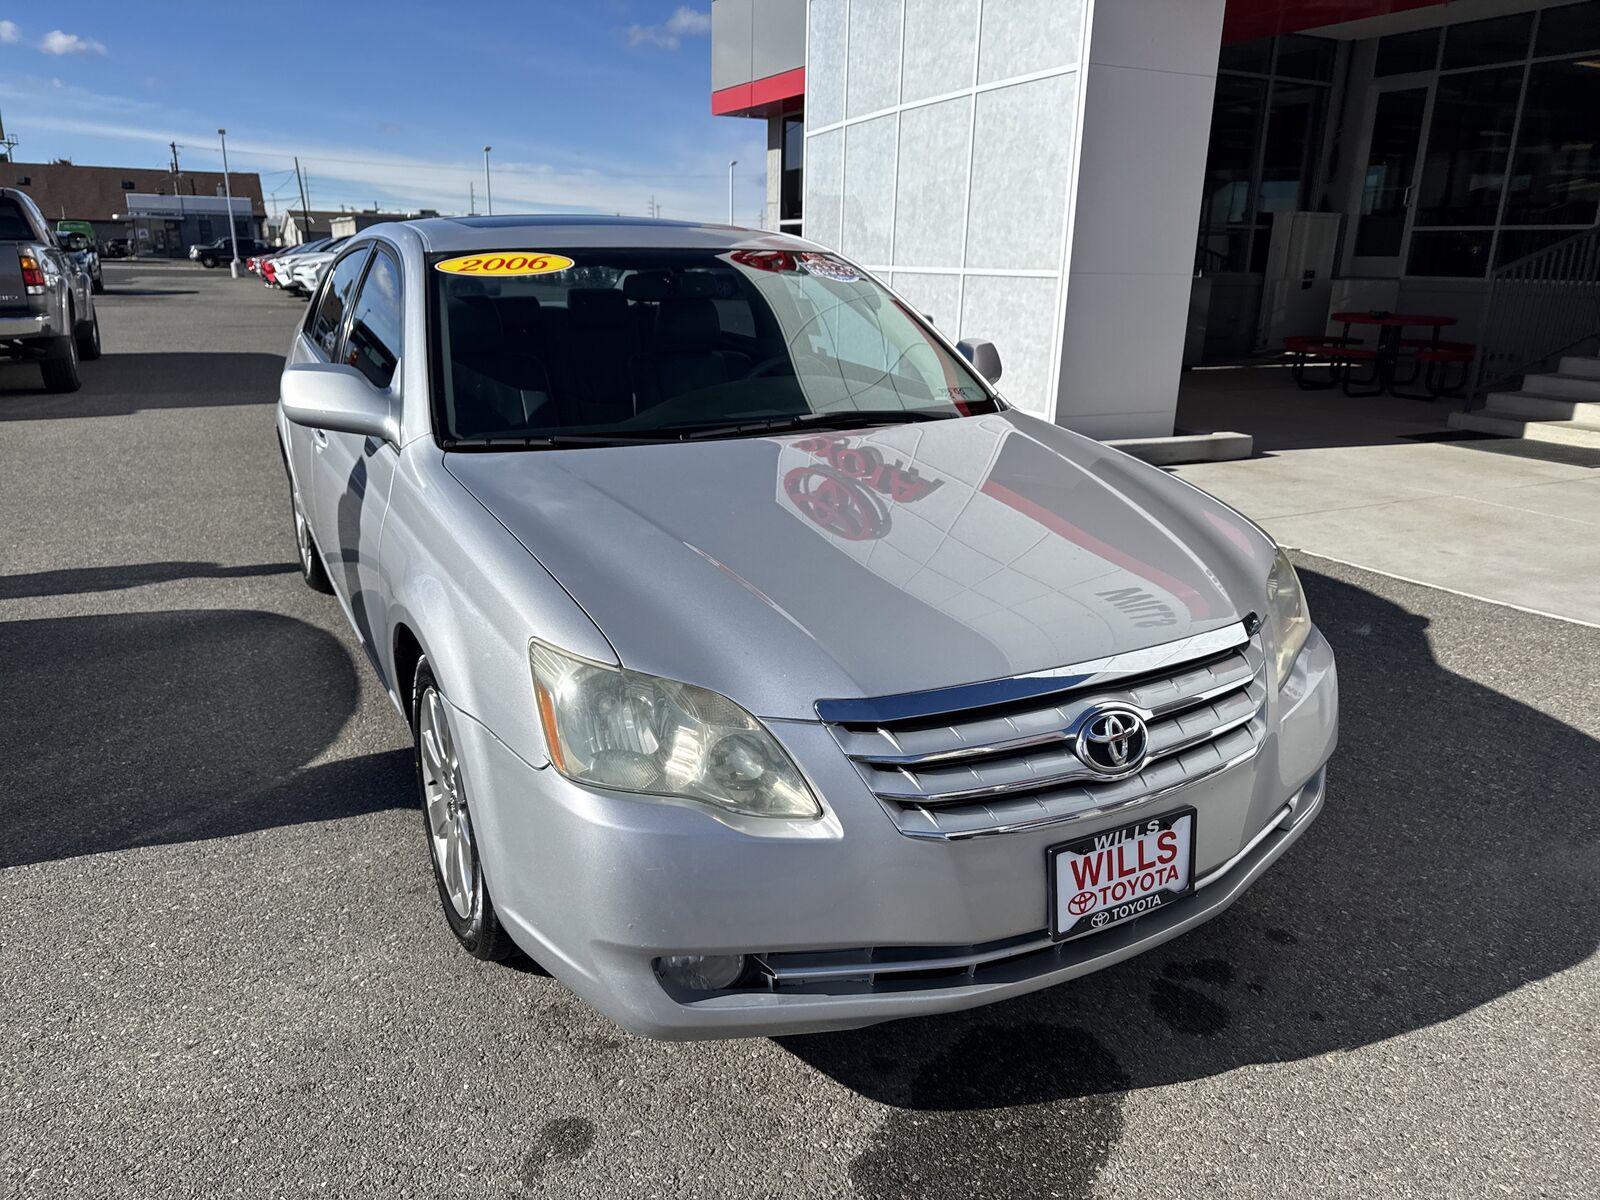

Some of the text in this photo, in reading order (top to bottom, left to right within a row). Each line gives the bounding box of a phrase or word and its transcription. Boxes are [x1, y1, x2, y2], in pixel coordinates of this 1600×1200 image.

[457, 255, 551, 272] 2006
[1094, 819, 1160, 850] WILLS
[1070, 831, 1178, 890] WILLS
[1099, 864, 1179, 905] TOYOTA
[1112, 894, 1161, 920] TOYOTA
